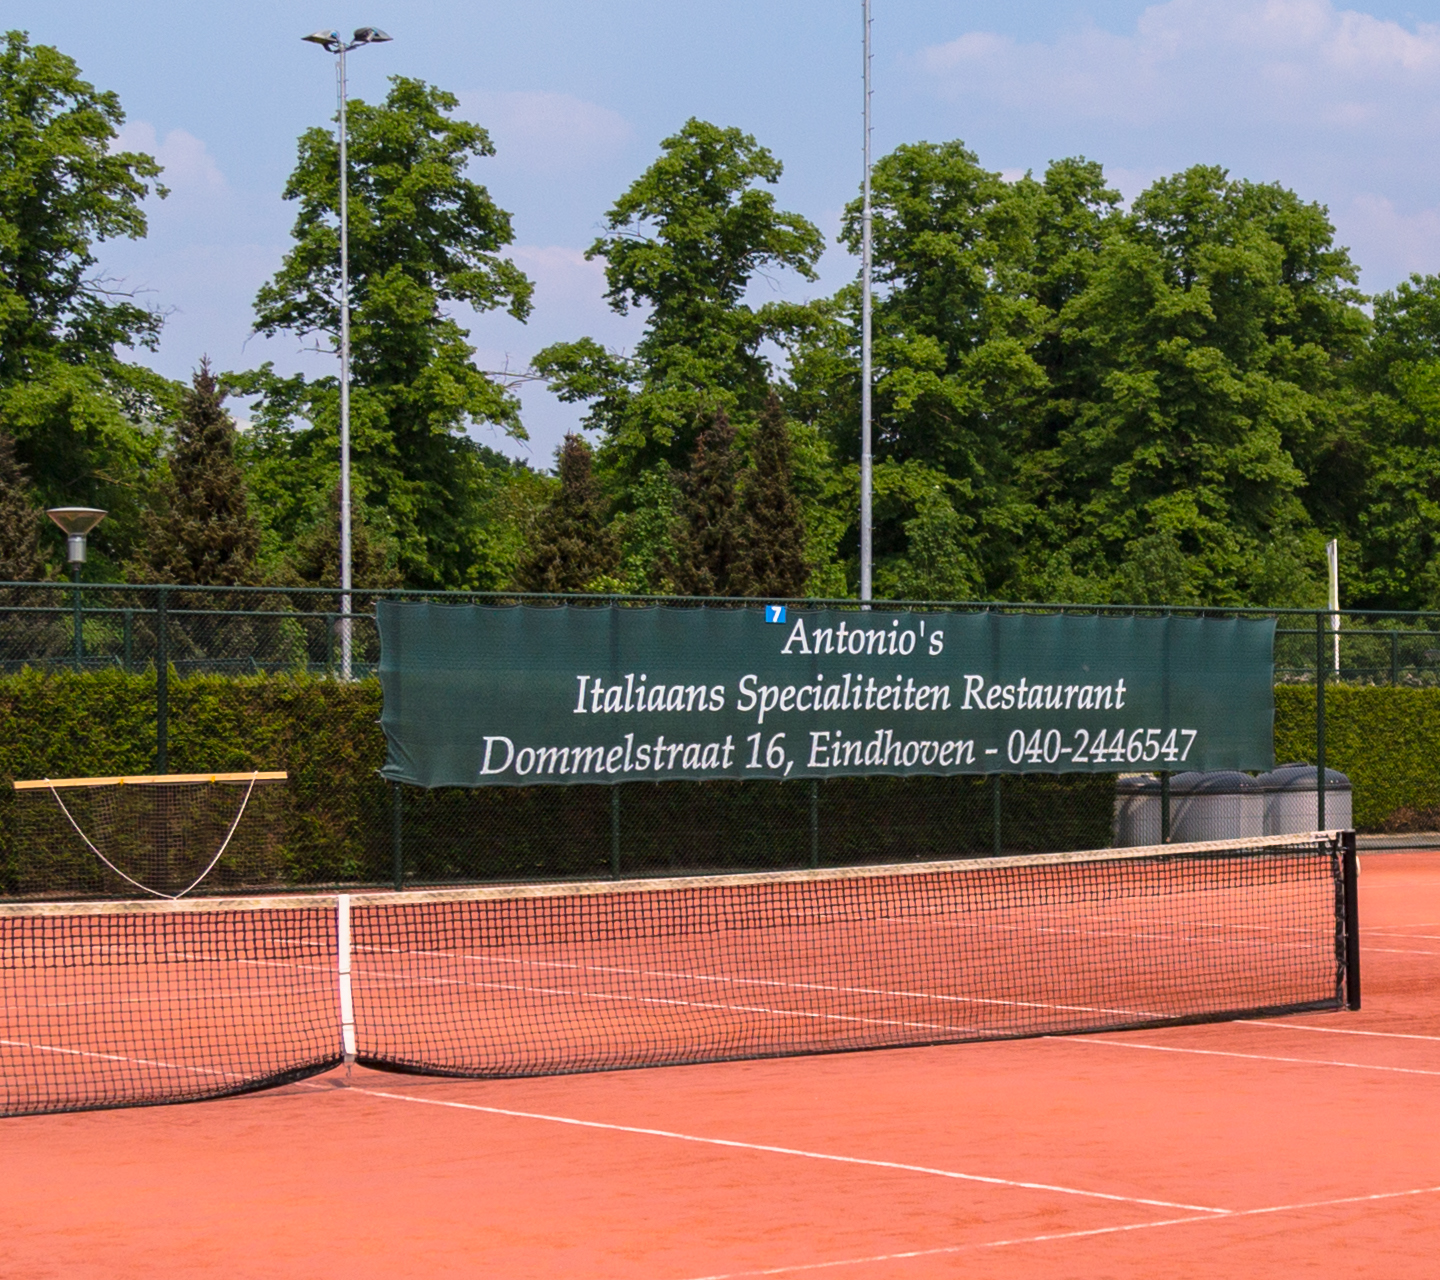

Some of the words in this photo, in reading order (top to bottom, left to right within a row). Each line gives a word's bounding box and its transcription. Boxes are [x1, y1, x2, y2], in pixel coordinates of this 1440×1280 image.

[771, 606, 782, 623] 7
[781, 618, 944, 656] Antonio's
[573, 673, 725, 714] Italiaans
[736, 672, 952, 724] Specialiteiten
[960, 674, 1127, 711] Restaurant
[479, 733, 736, 776] Dommelstraat
[745, 732, 794, 777] 16,
[807, 728, 976, 768] Eindhoven
[1007, 728, 1198, 765] 040-2446547
